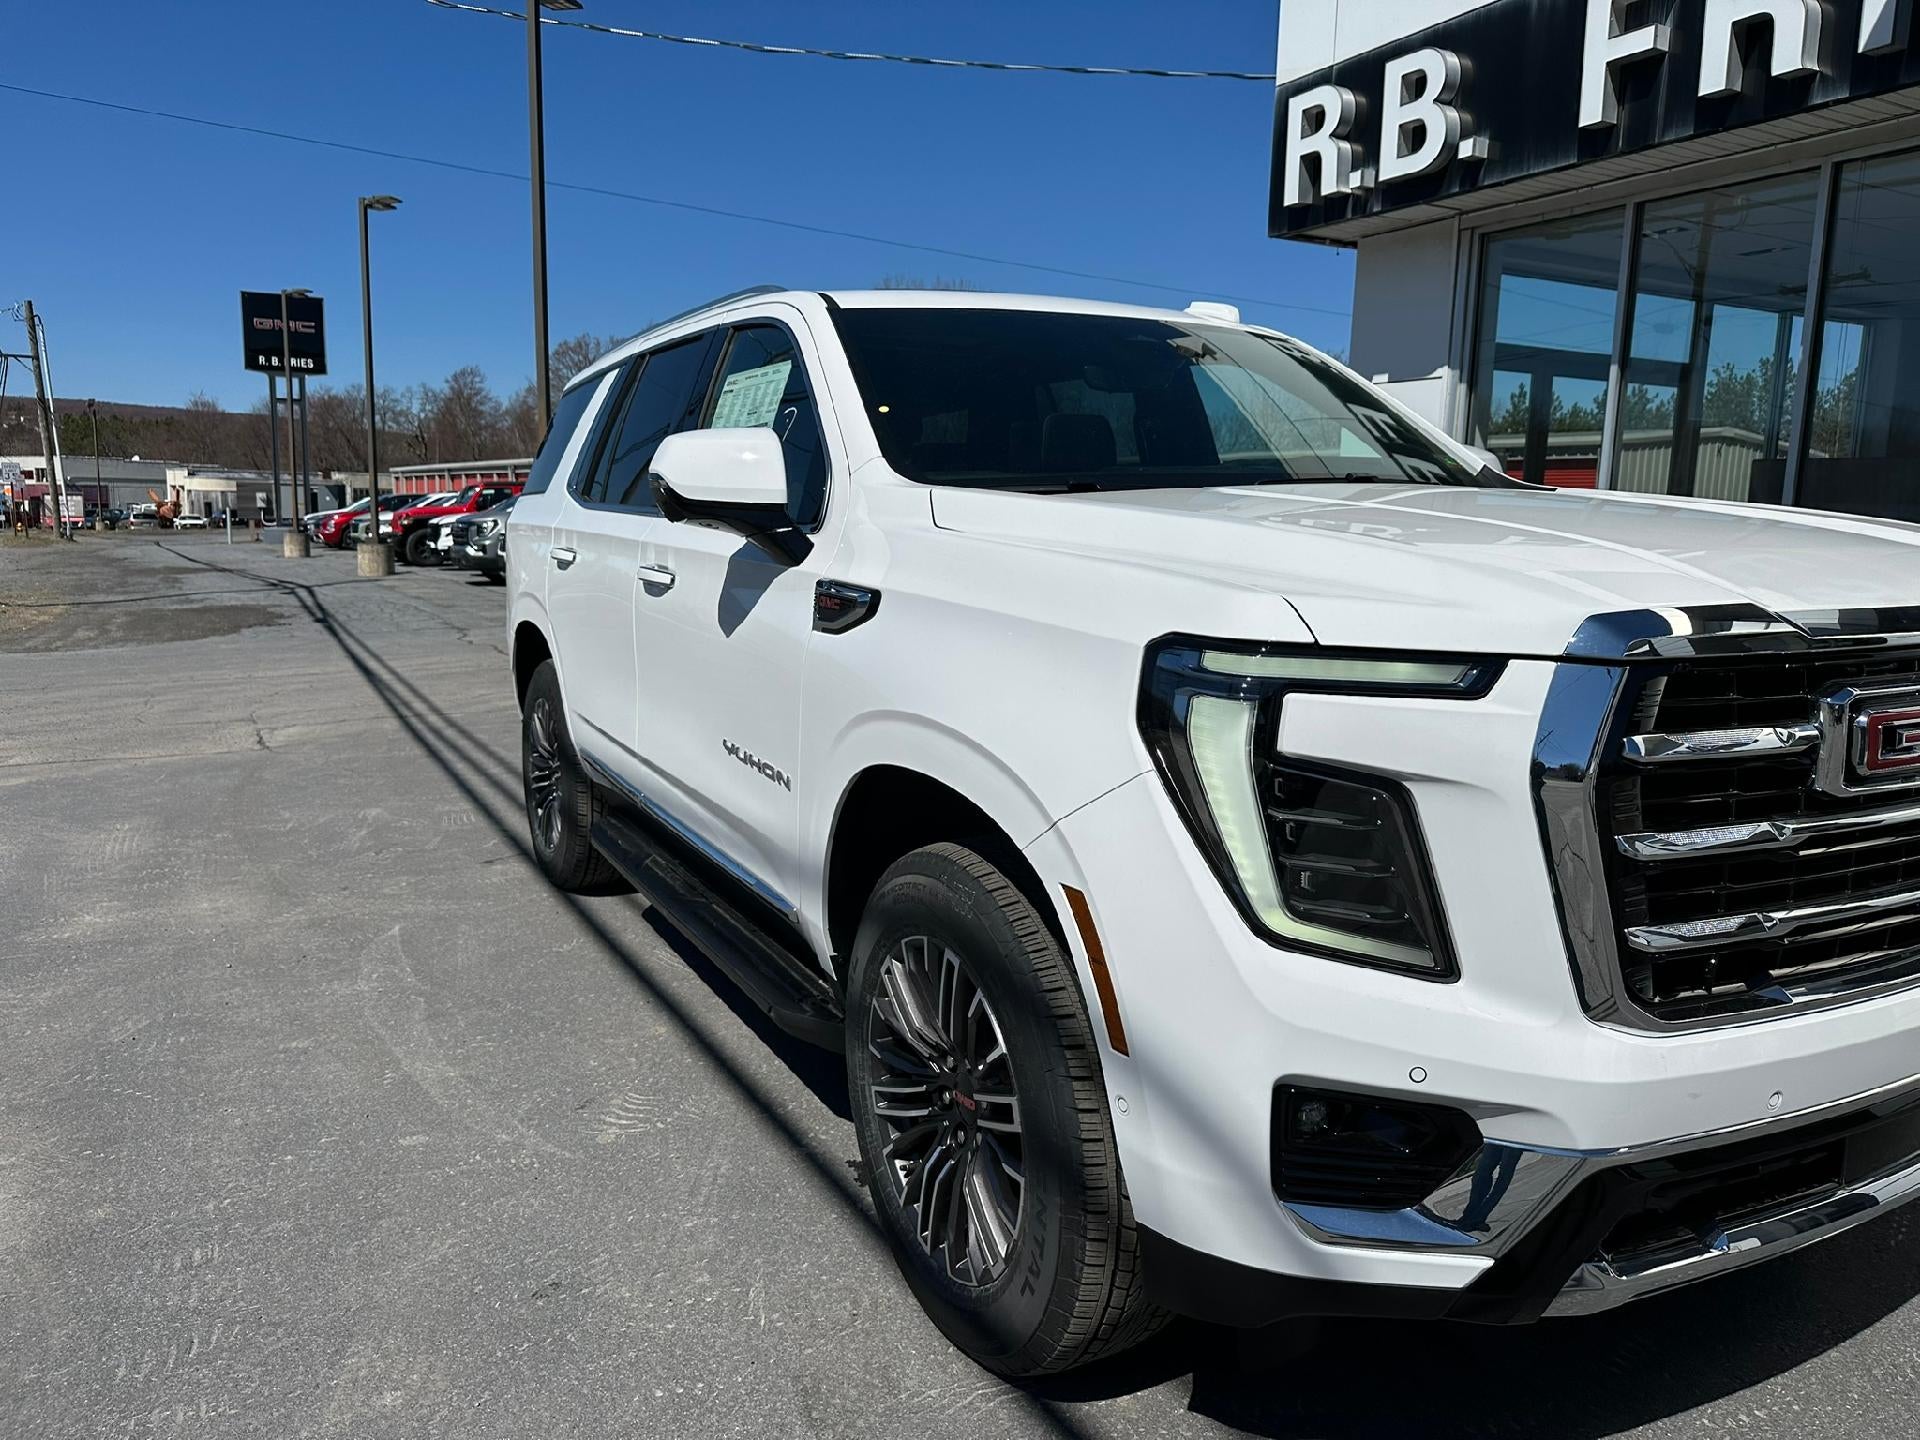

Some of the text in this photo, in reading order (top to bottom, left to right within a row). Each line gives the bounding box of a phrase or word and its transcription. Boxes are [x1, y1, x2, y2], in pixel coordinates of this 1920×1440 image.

[1578, 0, 1909, 130] FR
[254, 317, 315, 333] GMC
[283, 357, 314, 369] RIES
[722, 738, 792, 792] YUKON
